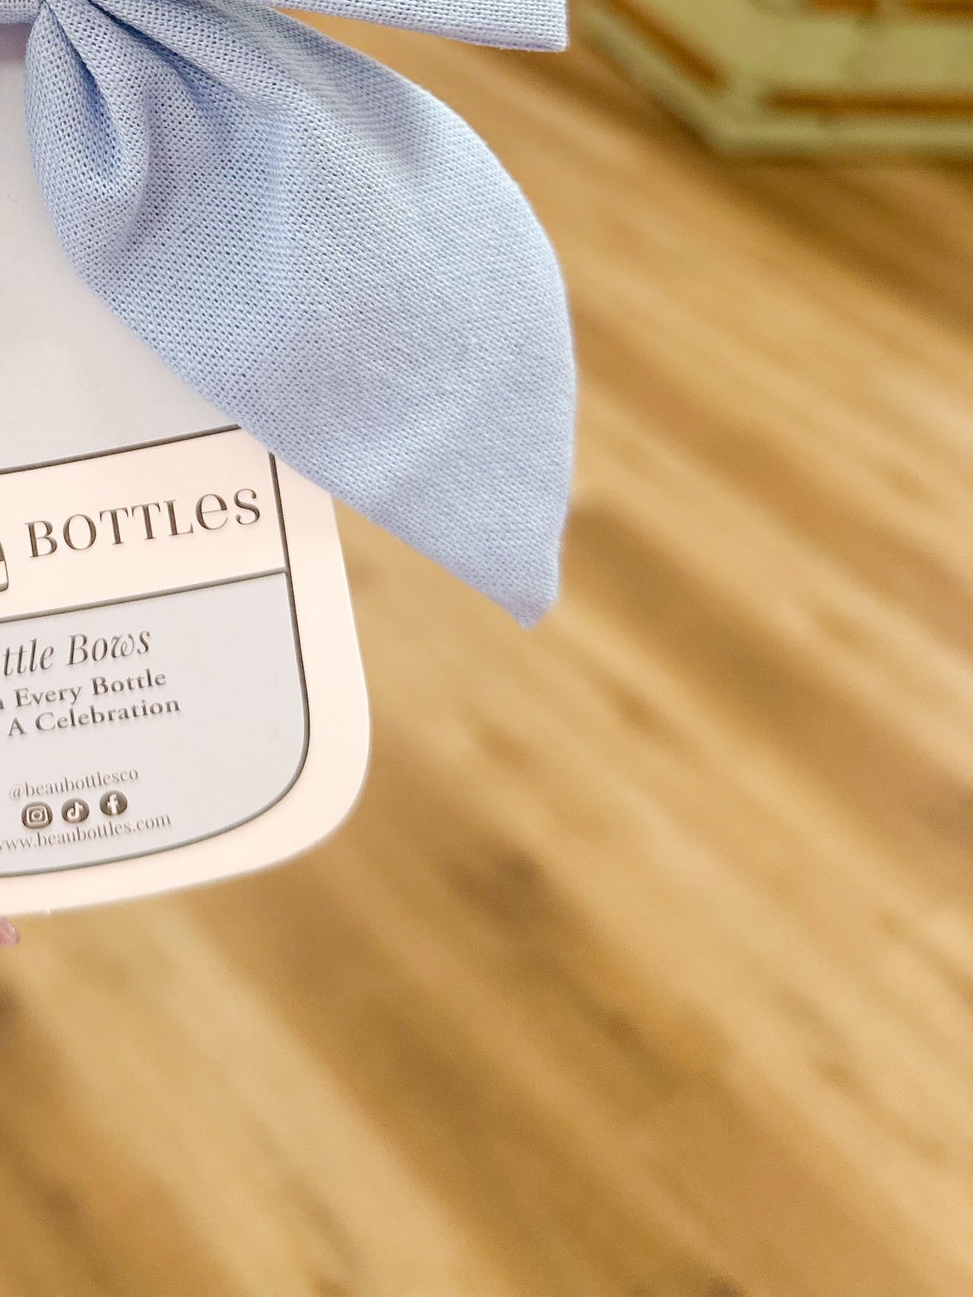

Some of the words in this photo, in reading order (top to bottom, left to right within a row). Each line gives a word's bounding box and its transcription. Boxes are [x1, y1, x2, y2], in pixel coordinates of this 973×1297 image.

[66, 628, 151, 666] Bows
[14, 685, 83, 708] Every
[90, 668, 167, 696] Bottle
[8, 717, 26, 737] A
[35, 698, 181, 732] Celebration
[9, 768, 139, 799] @beaubottlesco
